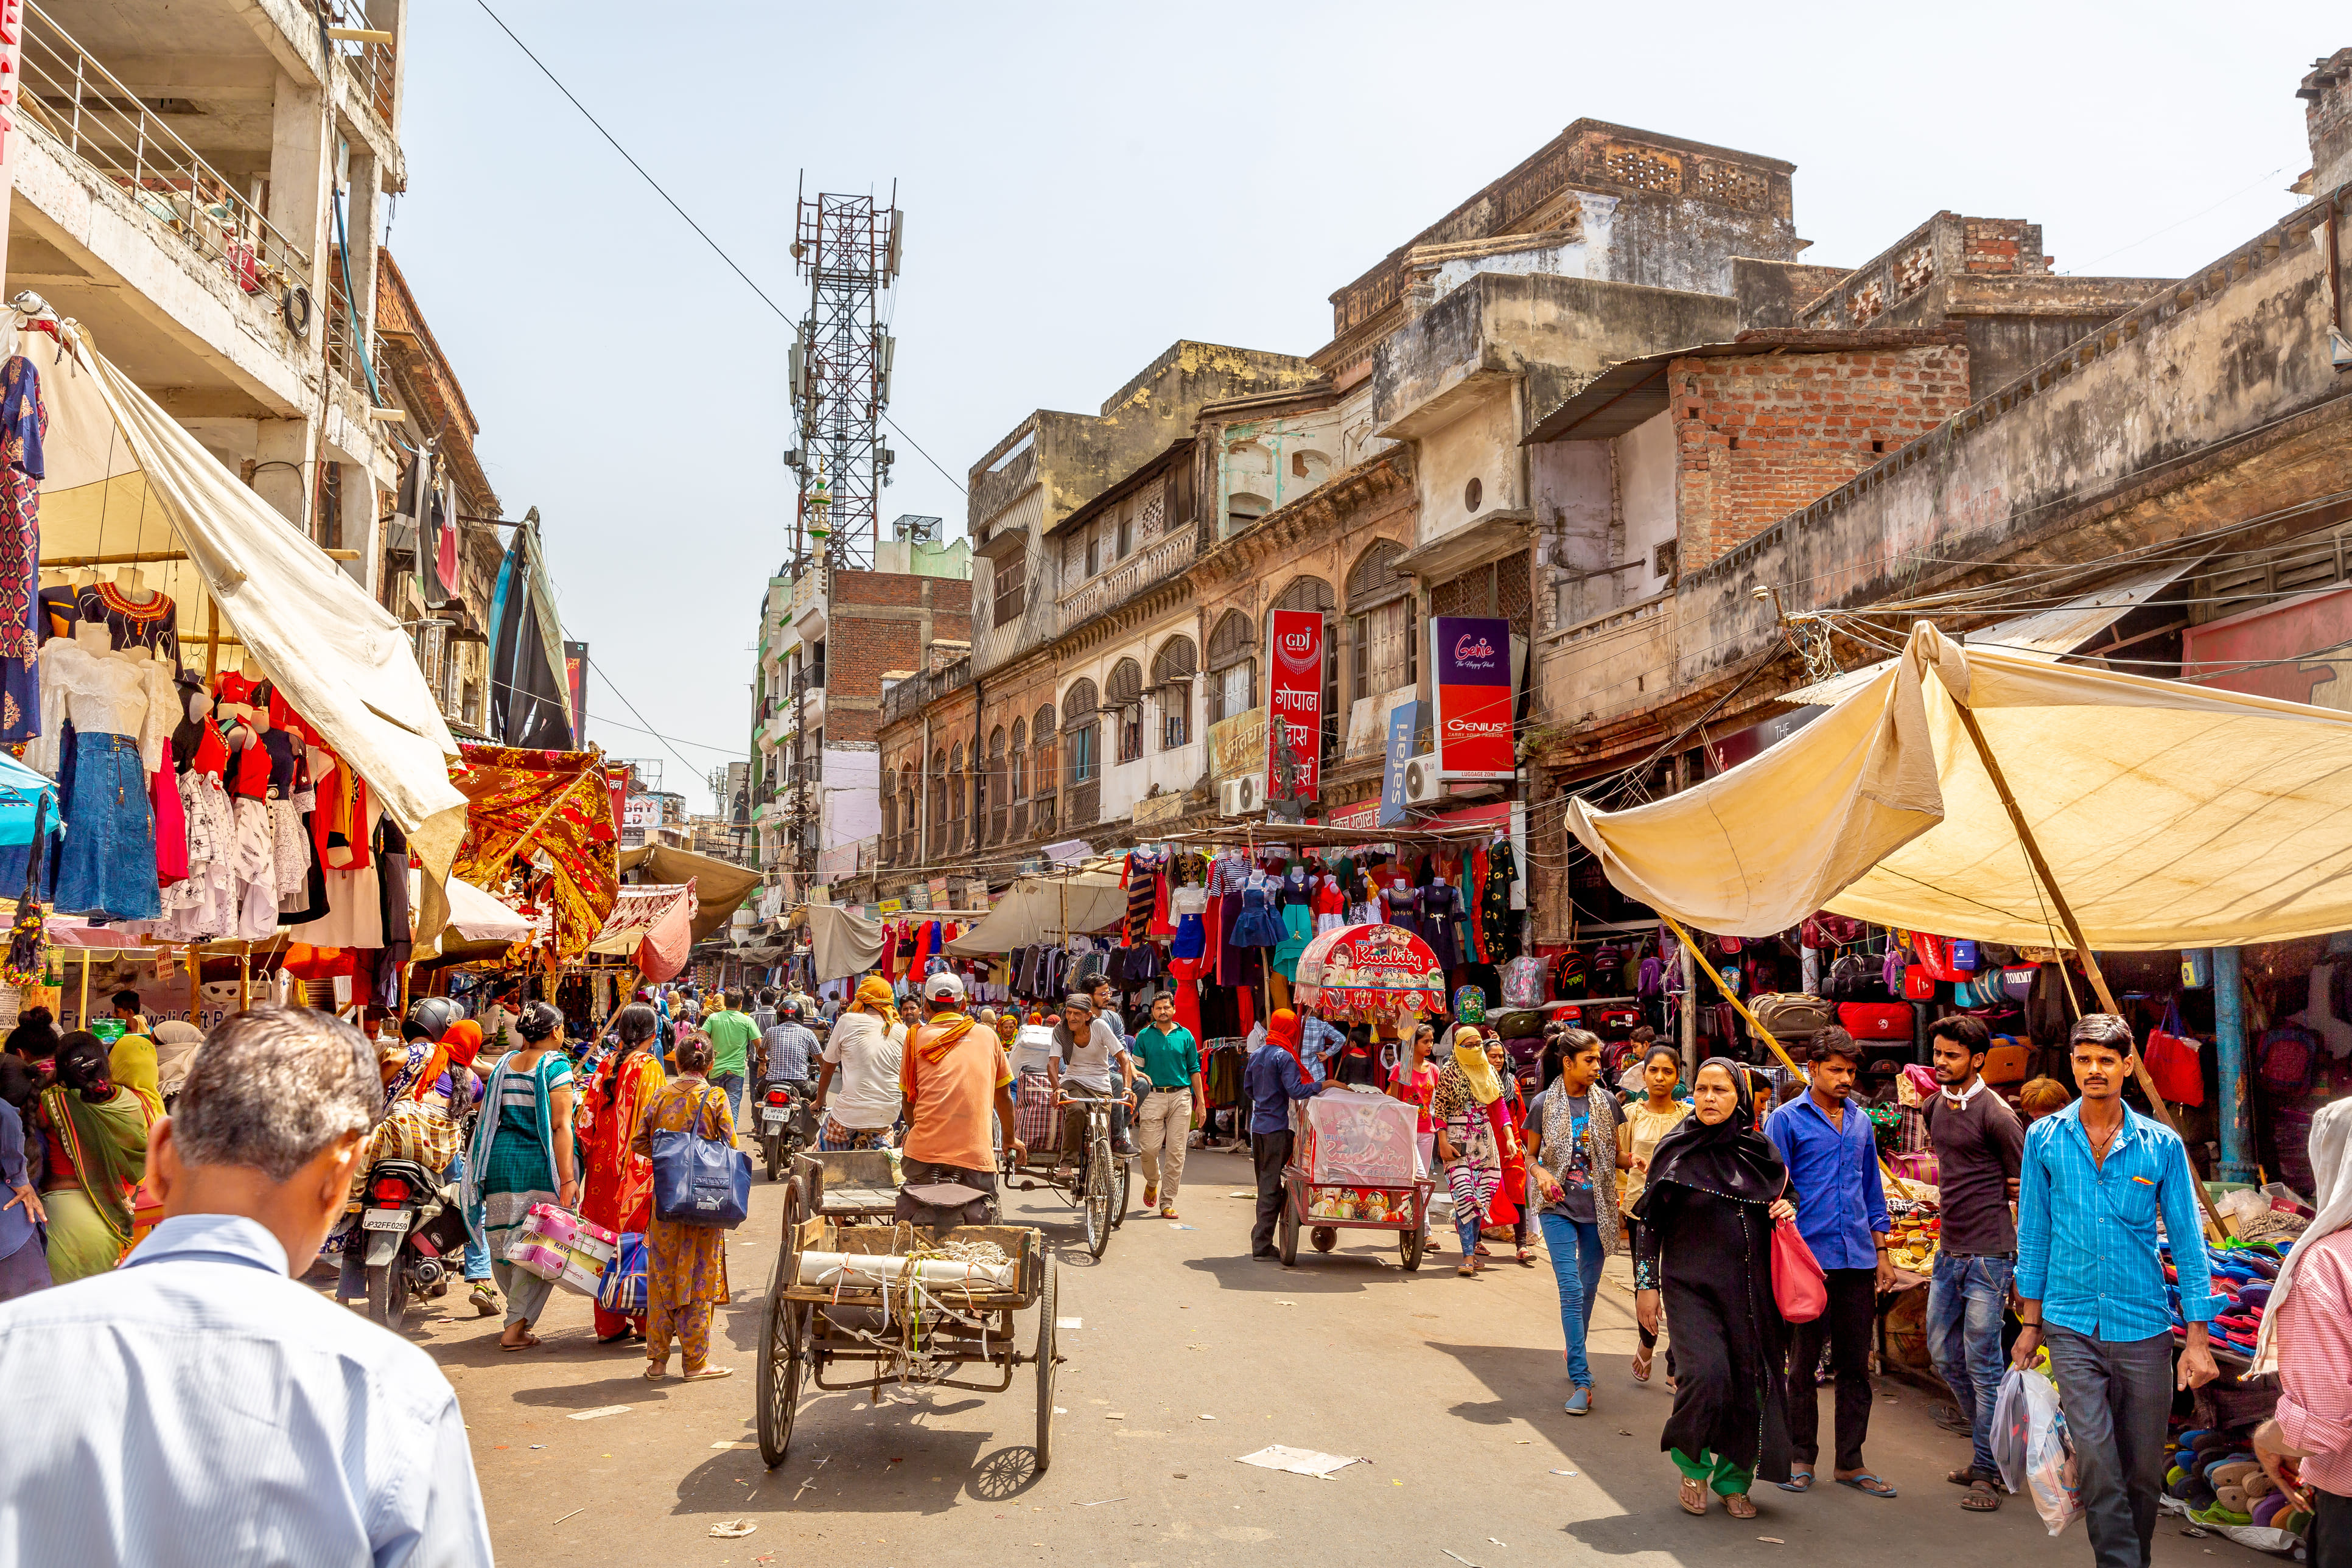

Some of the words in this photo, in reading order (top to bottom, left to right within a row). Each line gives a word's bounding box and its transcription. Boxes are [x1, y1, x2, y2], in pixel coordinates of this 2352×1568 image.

[1286, 632, 1311, 651] GDJ
[1455, 634, 1494, 660] Genie
[1465, 661, 1481, 670] Happy
[1275, 682, 1318, 712] गोपाल
[1391, 724, 1408, 804] safari
[1355, 945, 1423, 971] Kwality
[2005, 971, 2032, 984] TOMMY
[142, 1010, 176, 1025] iwali
[181, 1010, 208, 1029] Gft
